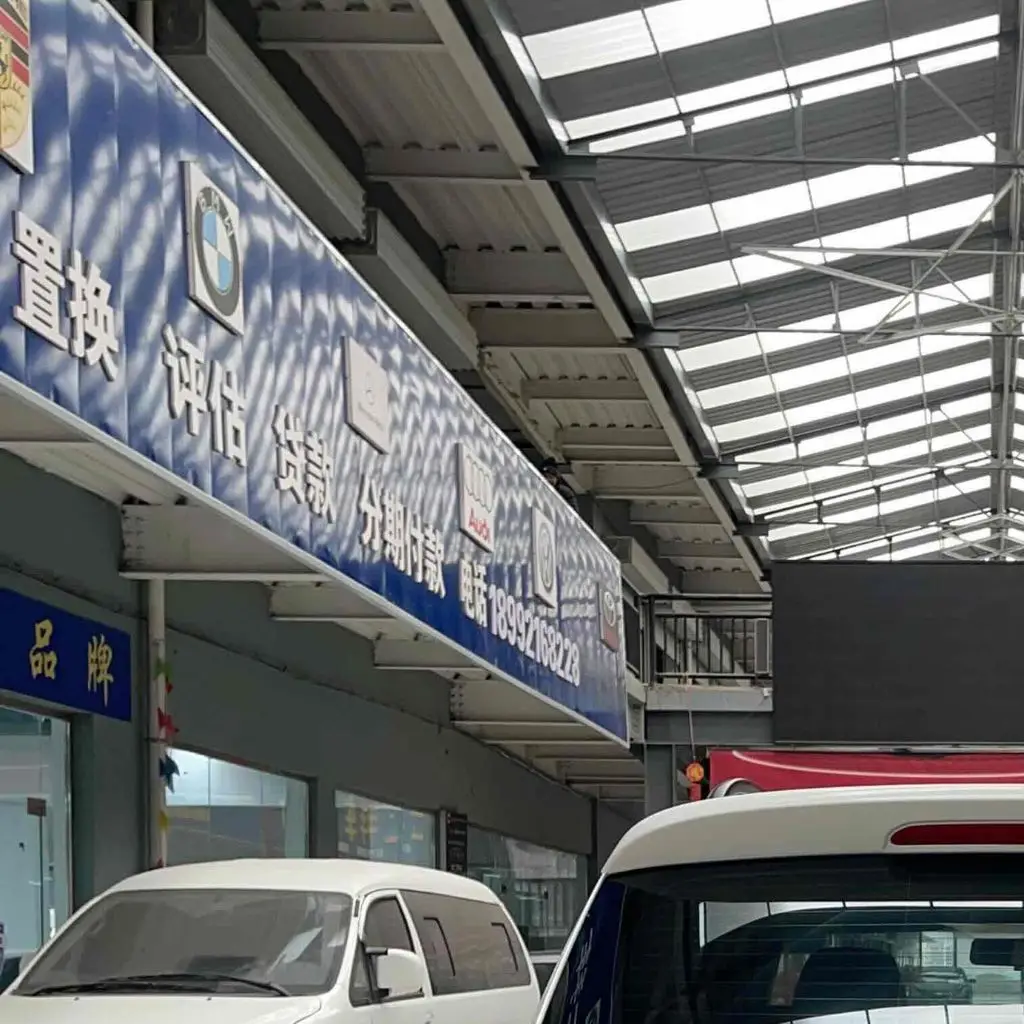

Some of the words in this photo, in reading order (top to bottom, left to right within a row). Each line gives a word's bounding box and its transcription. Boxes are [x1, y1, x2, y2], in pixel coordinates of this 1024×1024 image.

[11, 210, 119, 382] 置换
[162, 323, 248, 468] 评估
[272, 404, 336, 524] 贷款
[359, 473, 446, 598] 分期付款
[29, 619, 114, 707] 品牌
